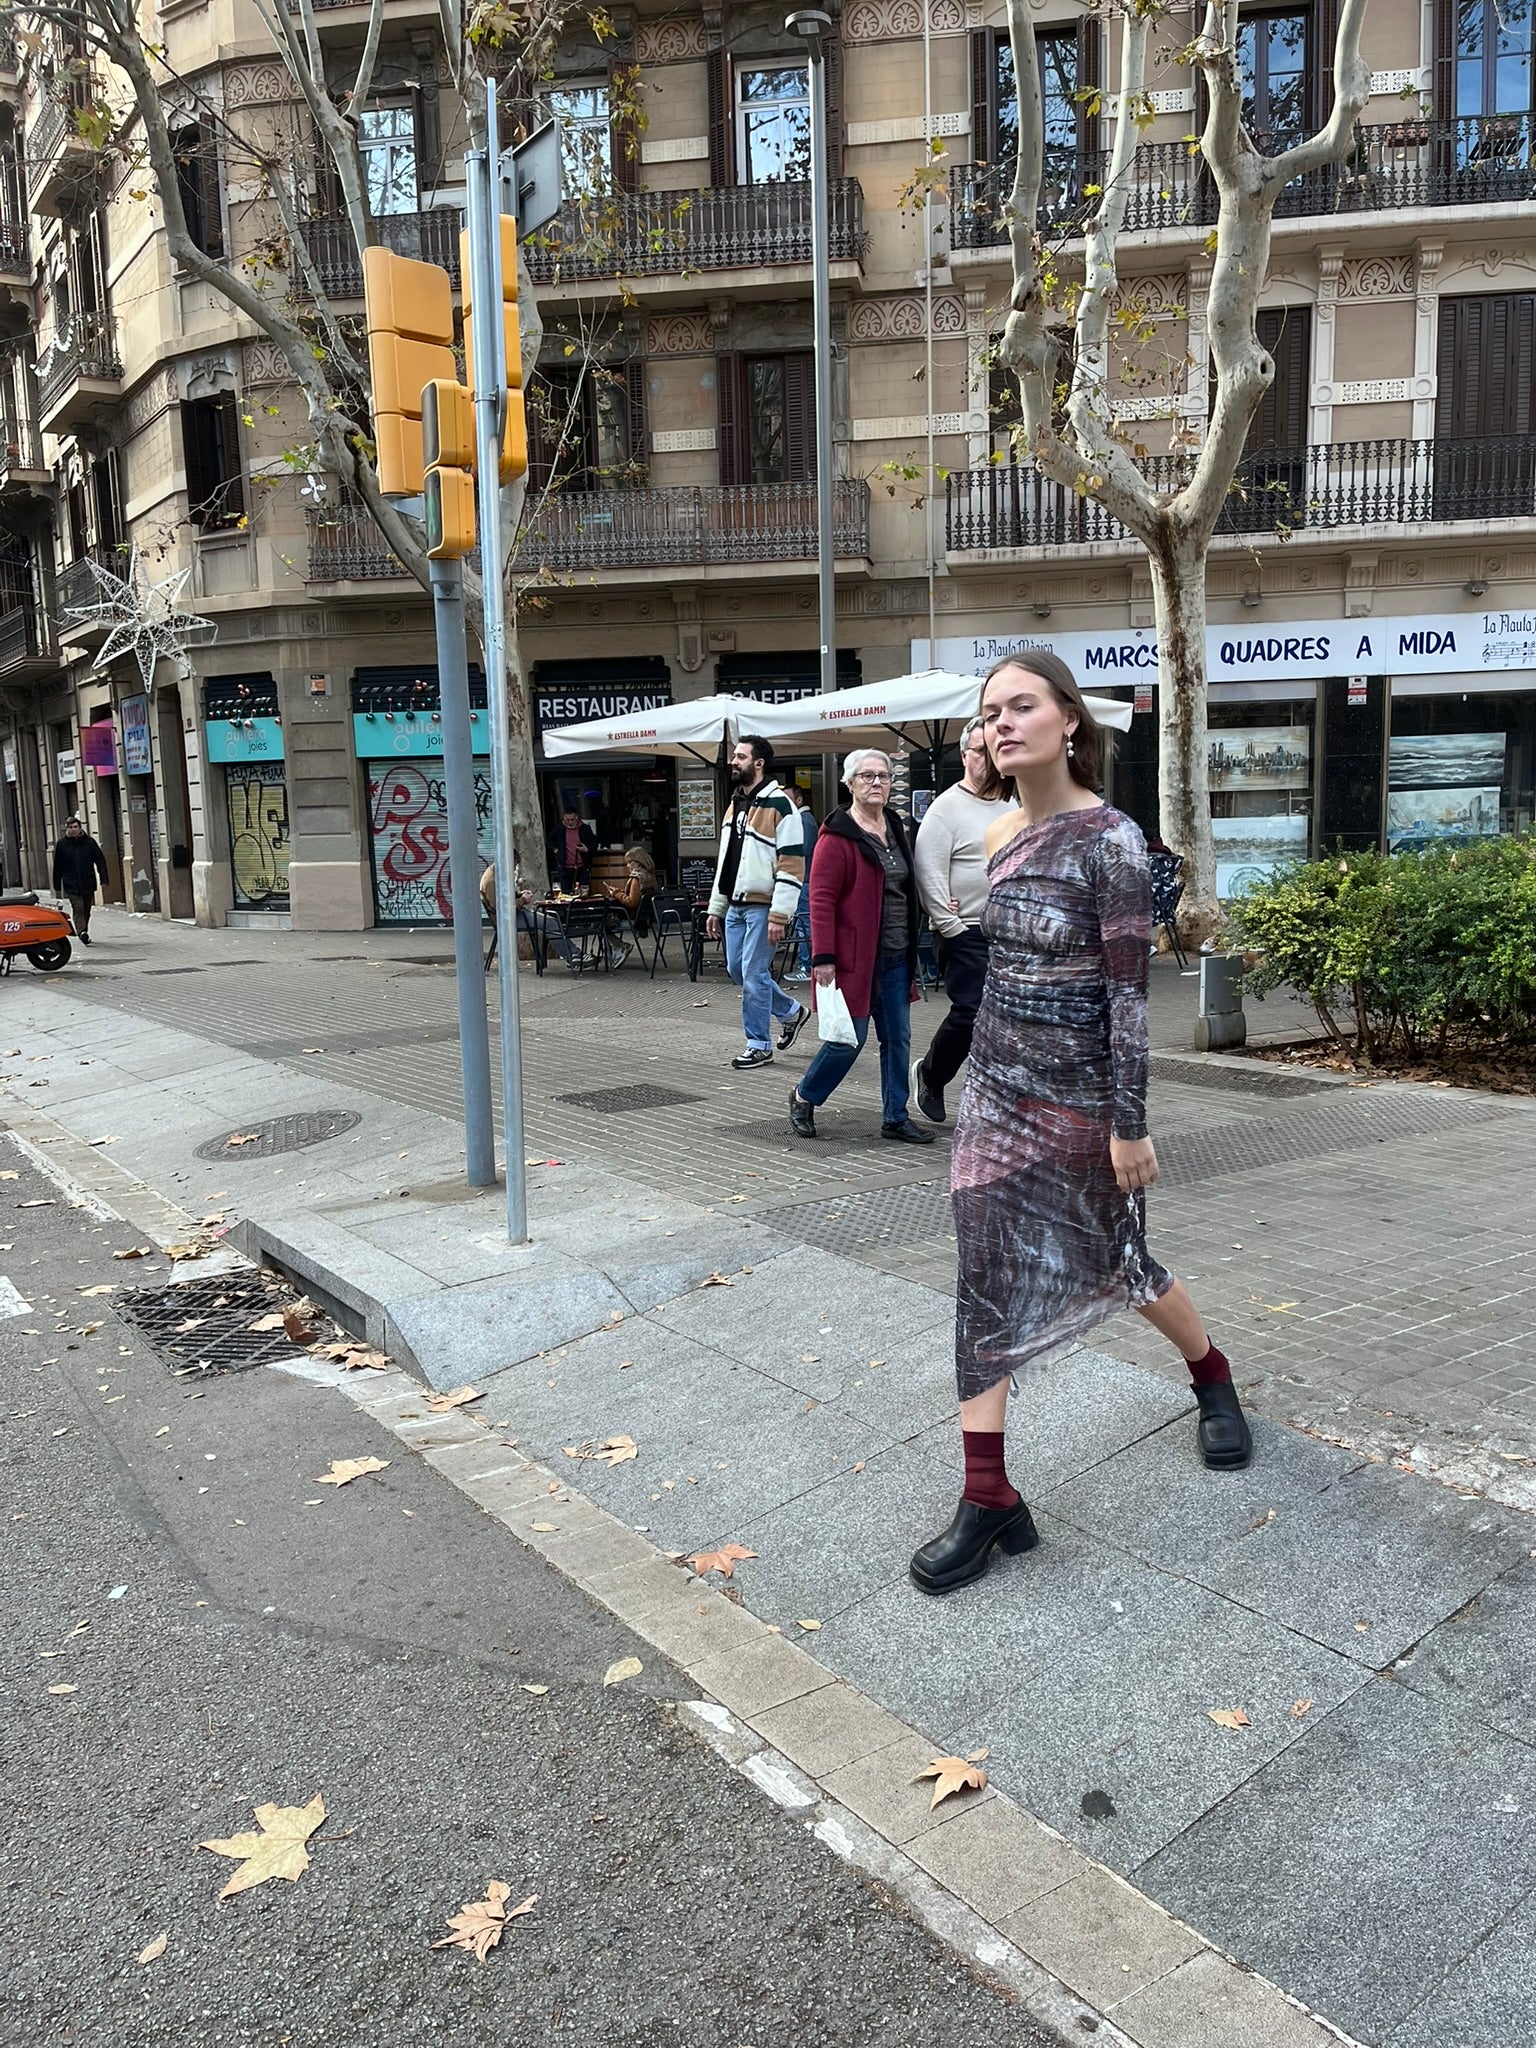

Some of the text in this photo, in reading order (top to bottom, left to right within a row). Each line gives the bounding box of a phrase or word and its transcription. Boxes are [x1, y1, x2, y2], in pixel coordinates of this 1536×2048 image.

[1220, 637, 1331, 666] QUADRES
[1356, 635, 1373, 659] A
[1399, 630, 1457, 656] MIDA
[539, 695, 669, 718] RESTAURANT
[829, 705, 886, 720] ESTRELLA DAMM
[426, 734, 444, 749] joi
[614, 729, 657, 740] ESTRELLA DAMM
[248, 741, 268, 754] joies
[4, 921, 20, 932] 125
